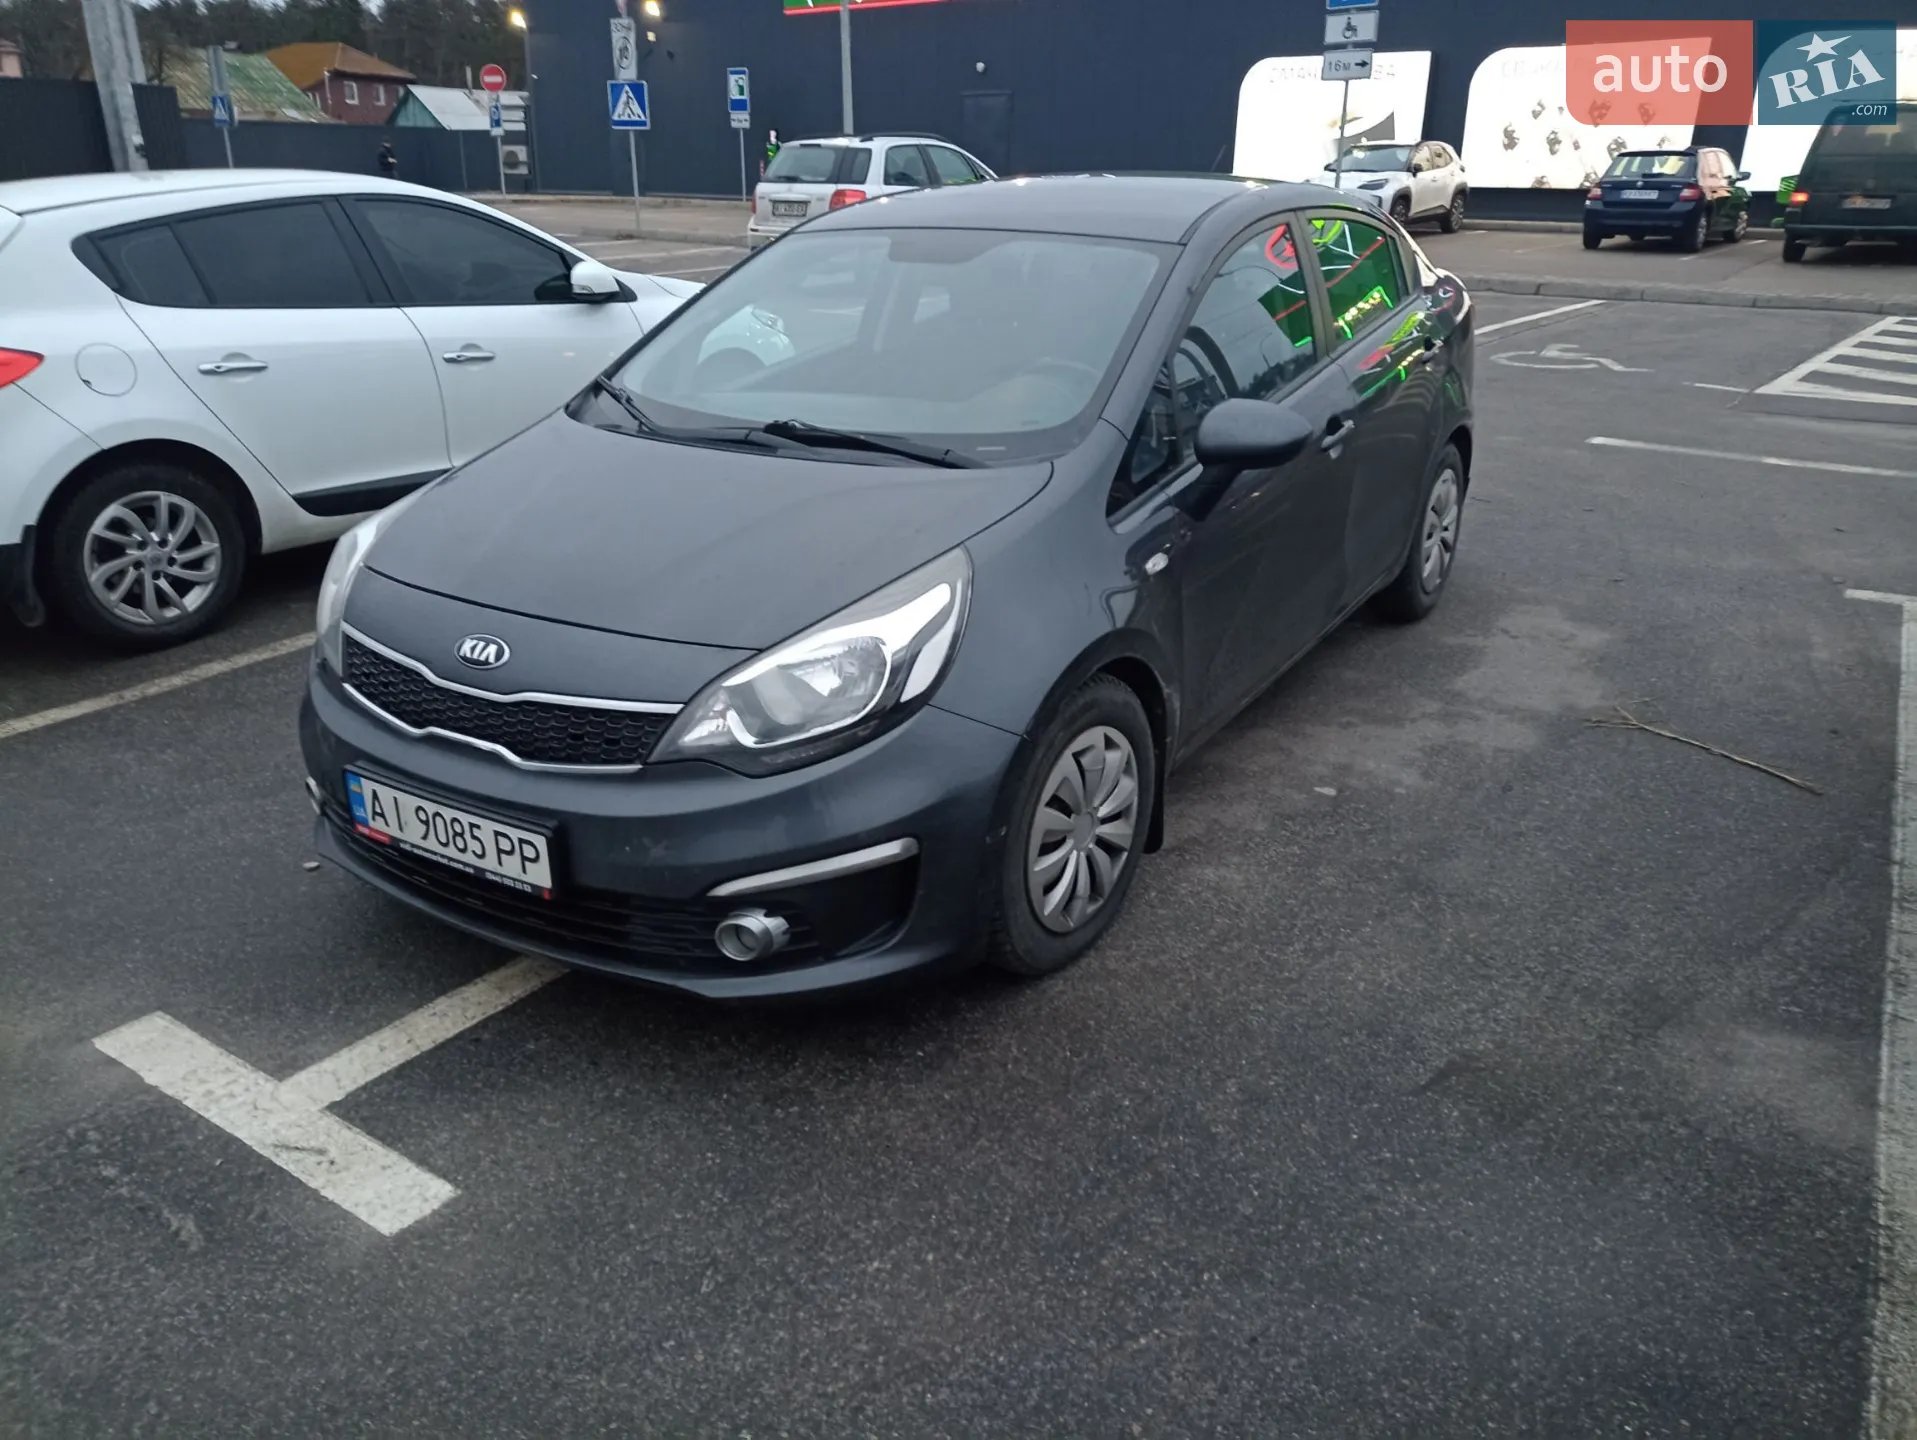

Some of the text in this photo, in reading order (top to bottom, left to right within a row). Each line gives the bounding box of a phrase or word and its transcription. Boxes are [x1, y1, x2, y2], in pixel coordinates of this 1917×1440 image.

[459, 638, 498, 664] KIA
[371, 788, 404, 834] AI
[415, 804, 487, 860] 9085
[492, 828, 541, 876] PP
